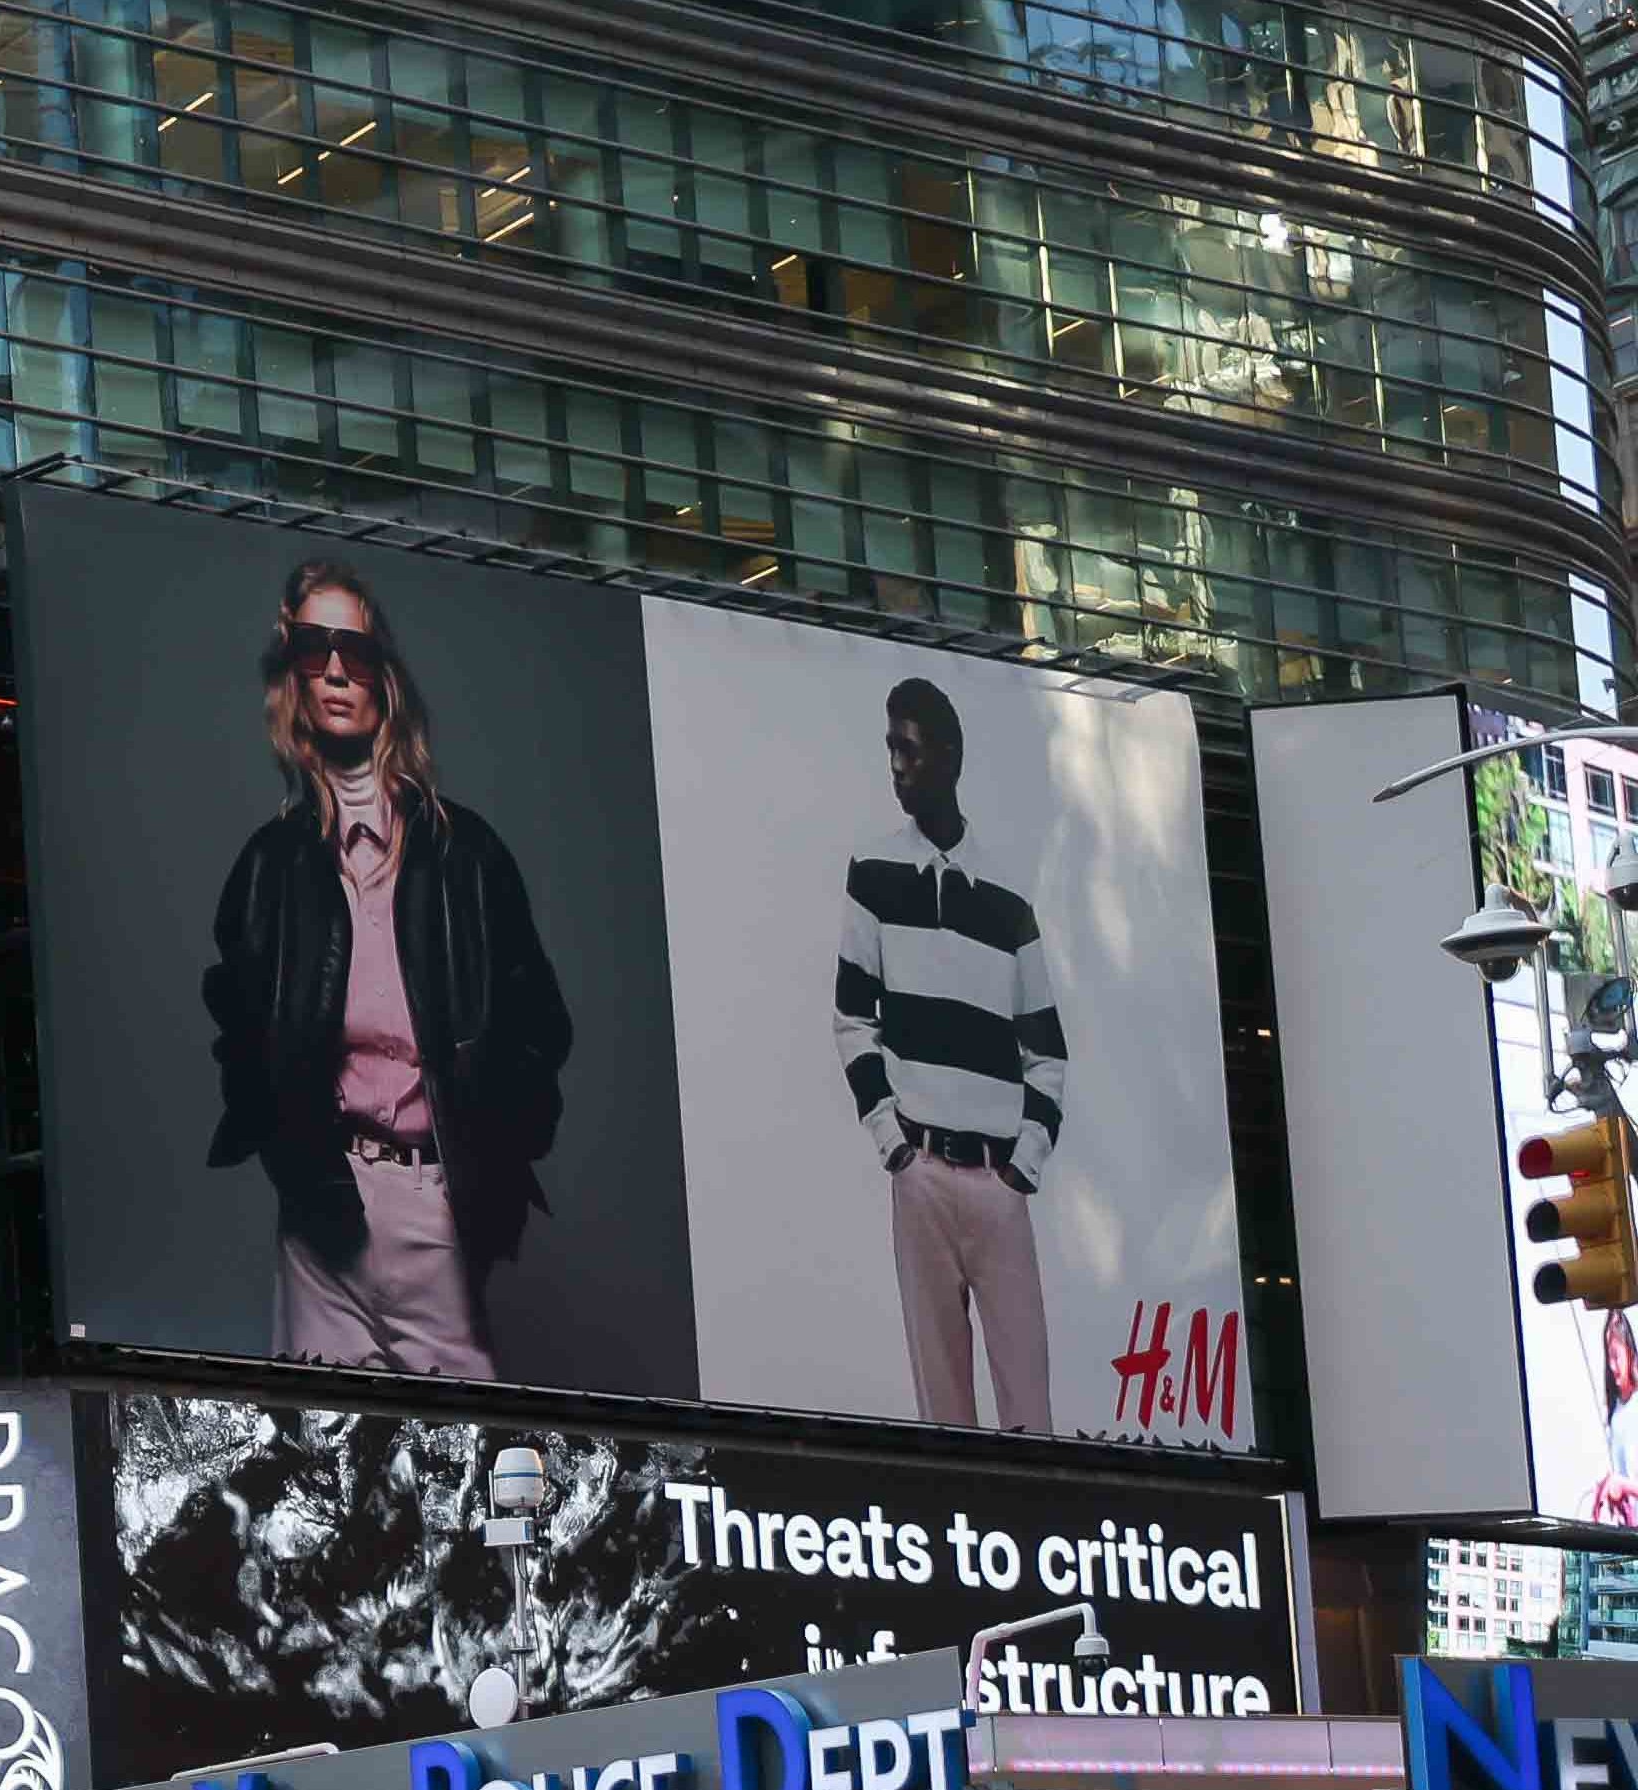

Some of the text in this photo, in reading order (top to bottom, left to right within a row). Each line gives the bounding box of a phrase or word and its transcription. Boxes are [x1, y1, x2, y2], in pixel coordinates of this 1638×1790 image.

[1112, 1300, 1239, 1438] H&M
[664, 1484, 1261, 1609] Threats to critical
